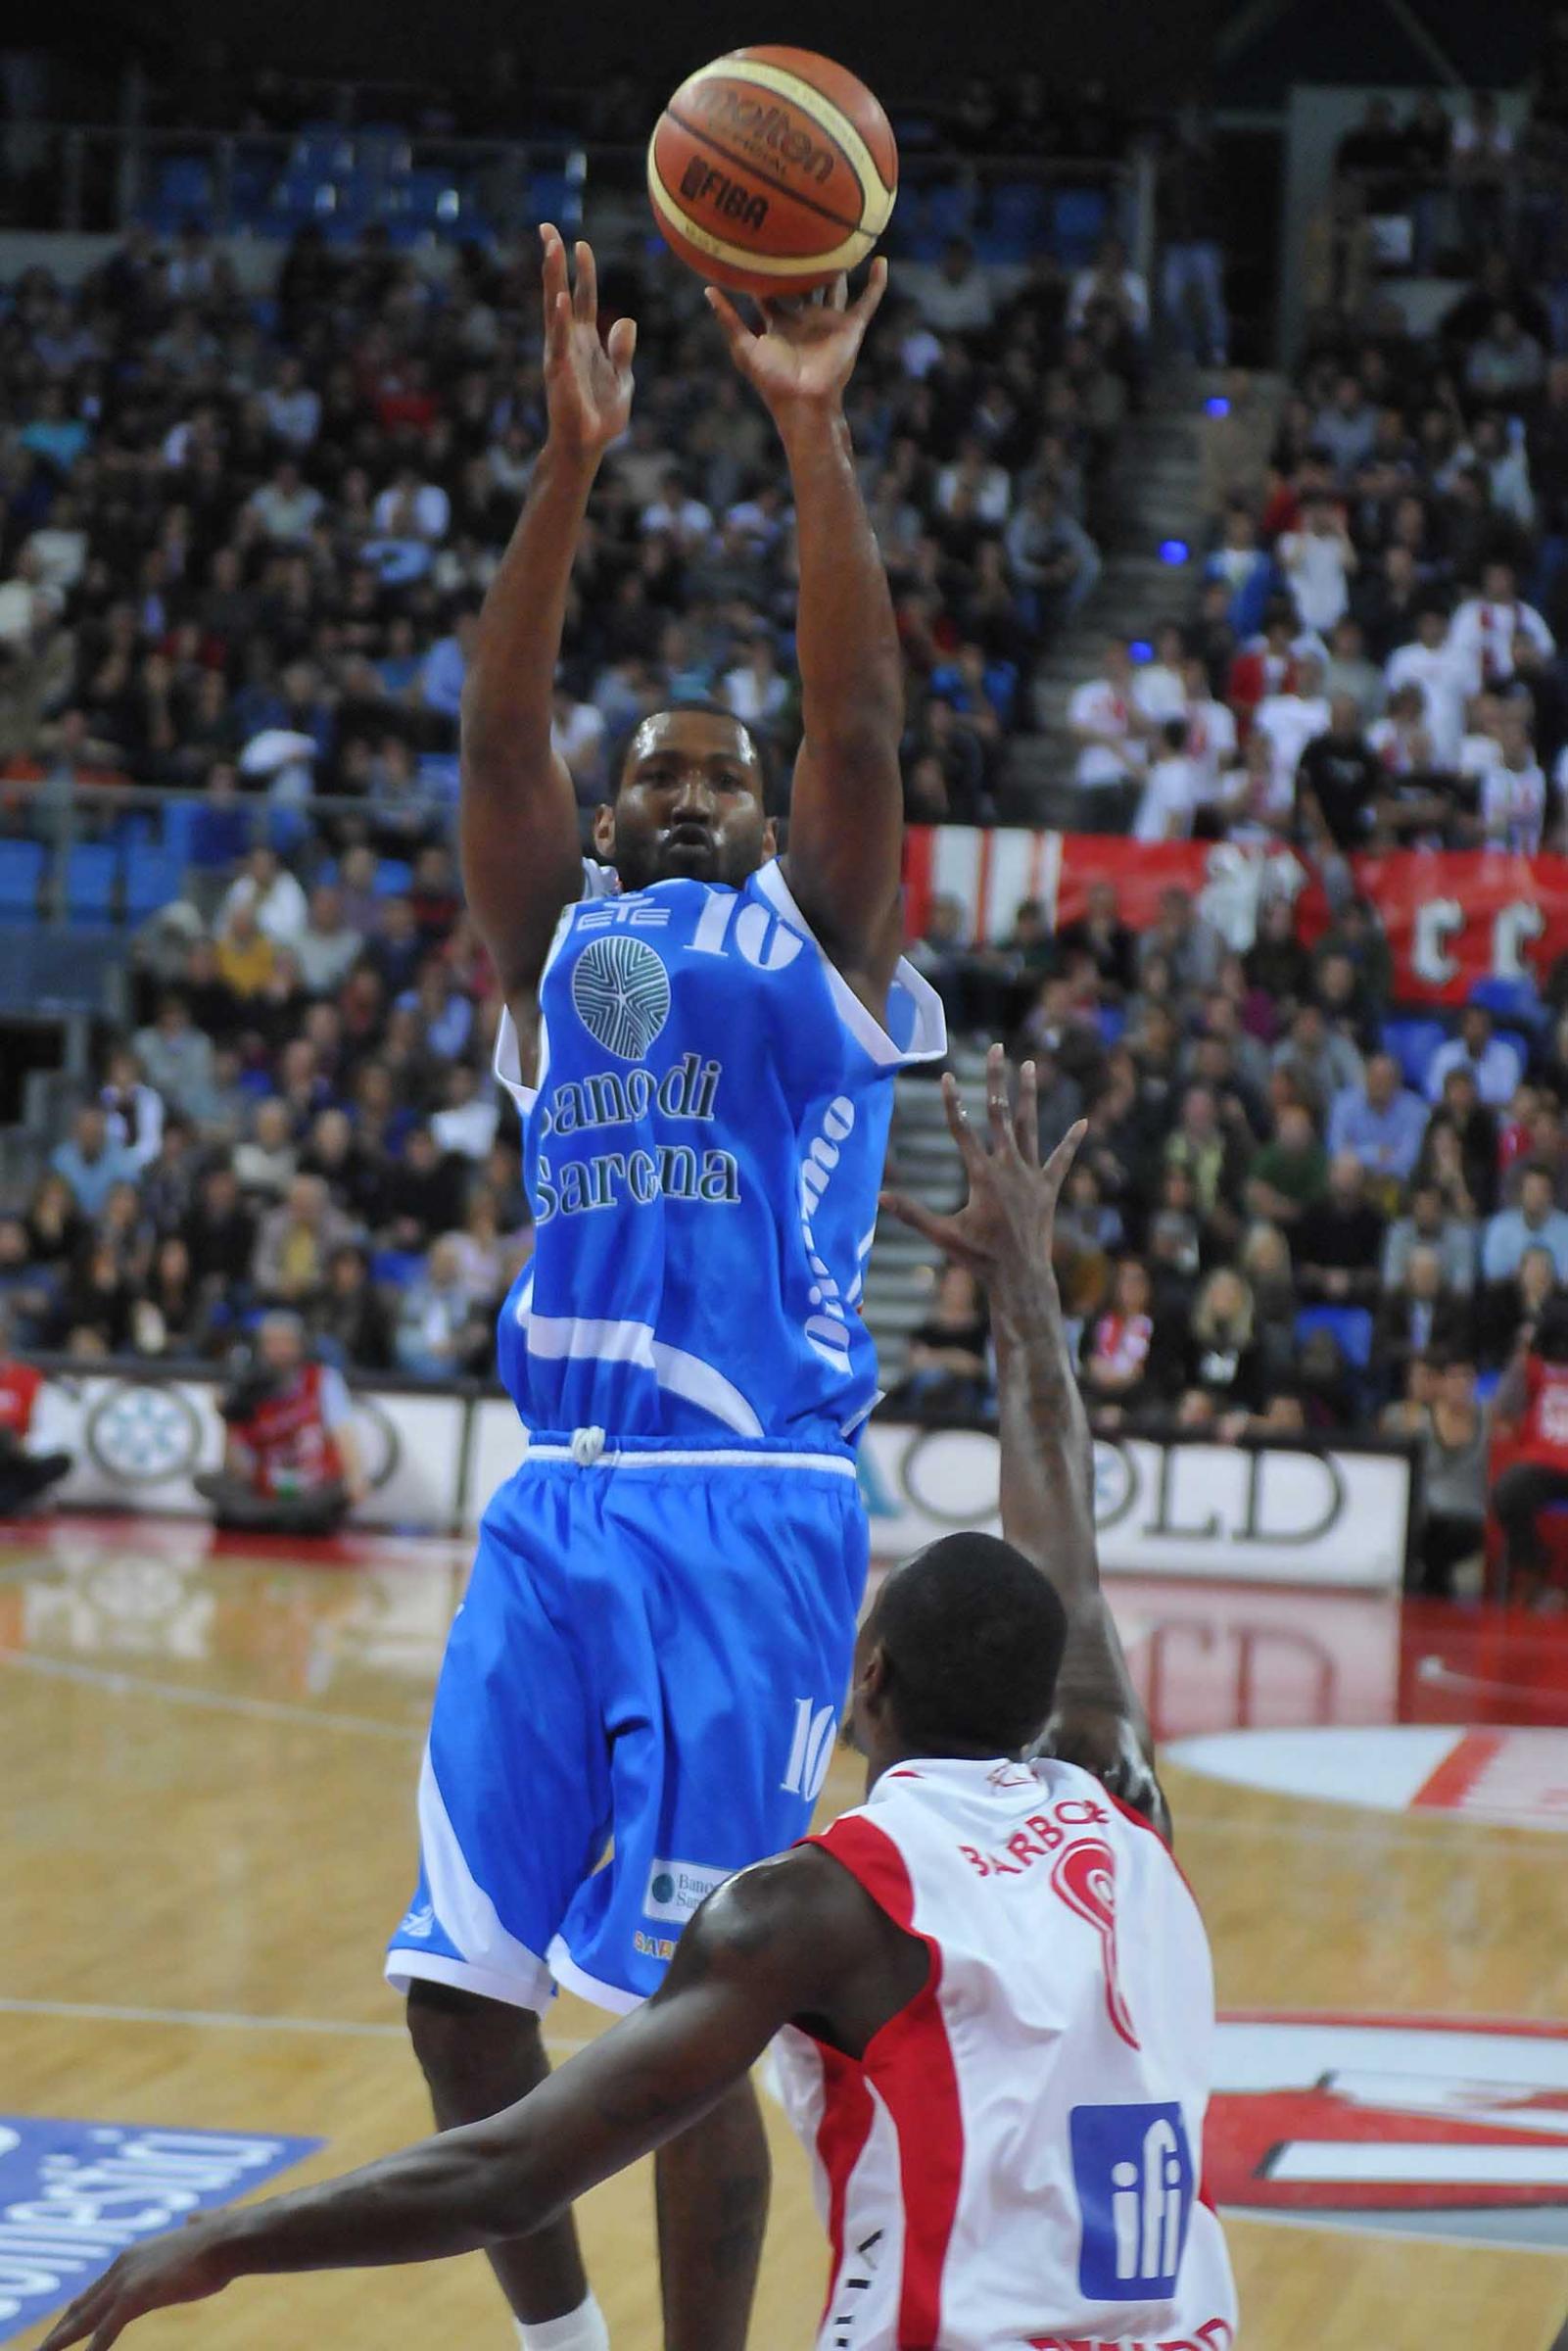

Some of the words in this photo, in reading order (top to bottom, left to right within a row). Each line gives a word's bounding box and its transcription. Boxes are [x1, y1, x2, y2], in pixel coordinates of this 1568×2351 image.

[683, 884, 804, 971] 10
[657, 1052, 723, 1121] di
[780, 1697, 838, 1802] 10
[1112, 2118, 1182, 2280] ifi
